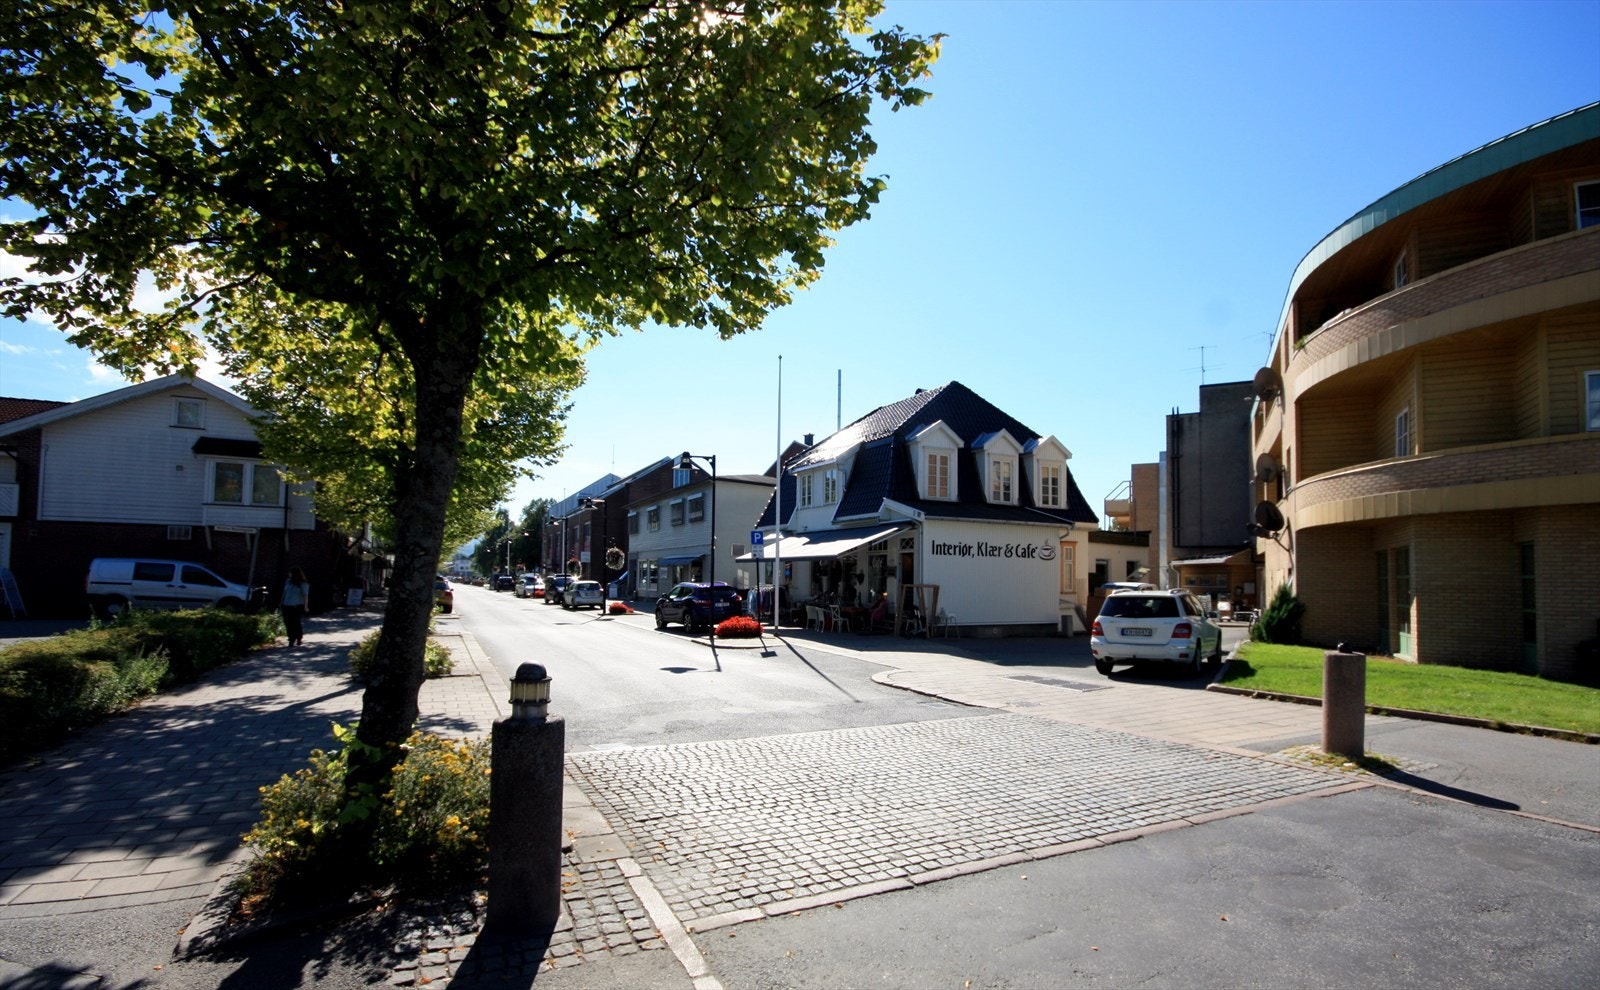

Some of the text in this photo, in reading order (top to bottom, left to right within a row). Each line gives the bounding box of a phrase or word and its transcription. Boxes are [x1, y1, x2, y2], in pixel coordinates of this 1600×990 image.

[754, 532, 761, 543] P
[931, 540, 975, 558] Interiør,
[977, 541, 1002, 557] Klær
[1004, 543, 1014, 558] &
